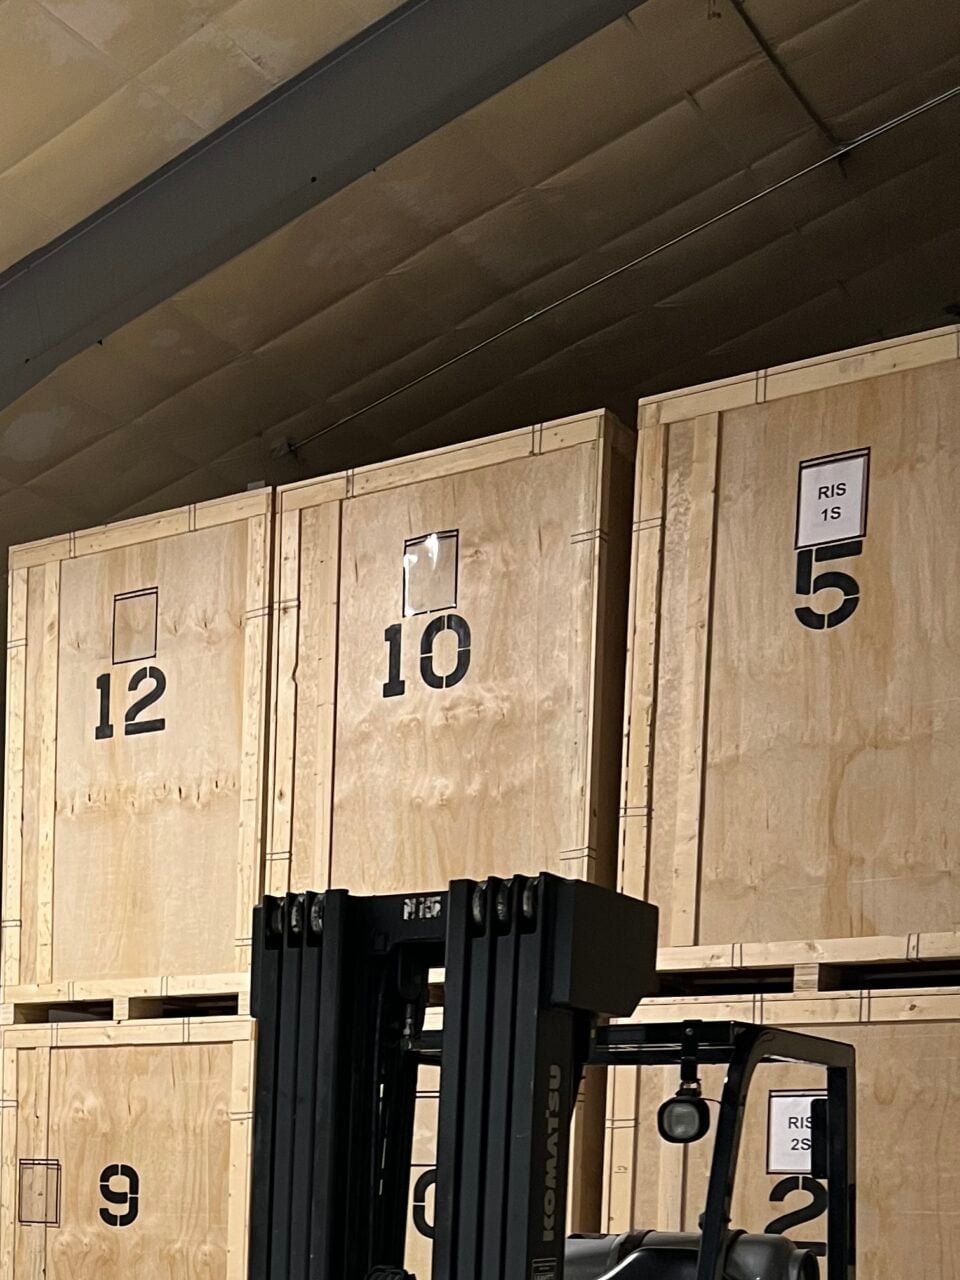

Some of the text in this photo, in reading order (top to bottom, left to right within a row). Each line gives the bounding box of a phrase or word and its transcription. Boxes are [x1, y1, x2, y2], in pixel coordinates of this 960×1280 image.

[817, 482, 847, 500] RIS
[821, 506, 842, 522] 1S
[794, 541, 863, 630] 5
[383, 614, 471, 698] 10
[95, 666, 166, 740] 12
[542, 1064, 561, 1241] KOMATSU
[788, 1116, 812, 1129] RIS
[790, 1138, 812, 1151] 2S
[100, 1163, 140, 1227] 9
[764, 1175, 828, 1257] 2
